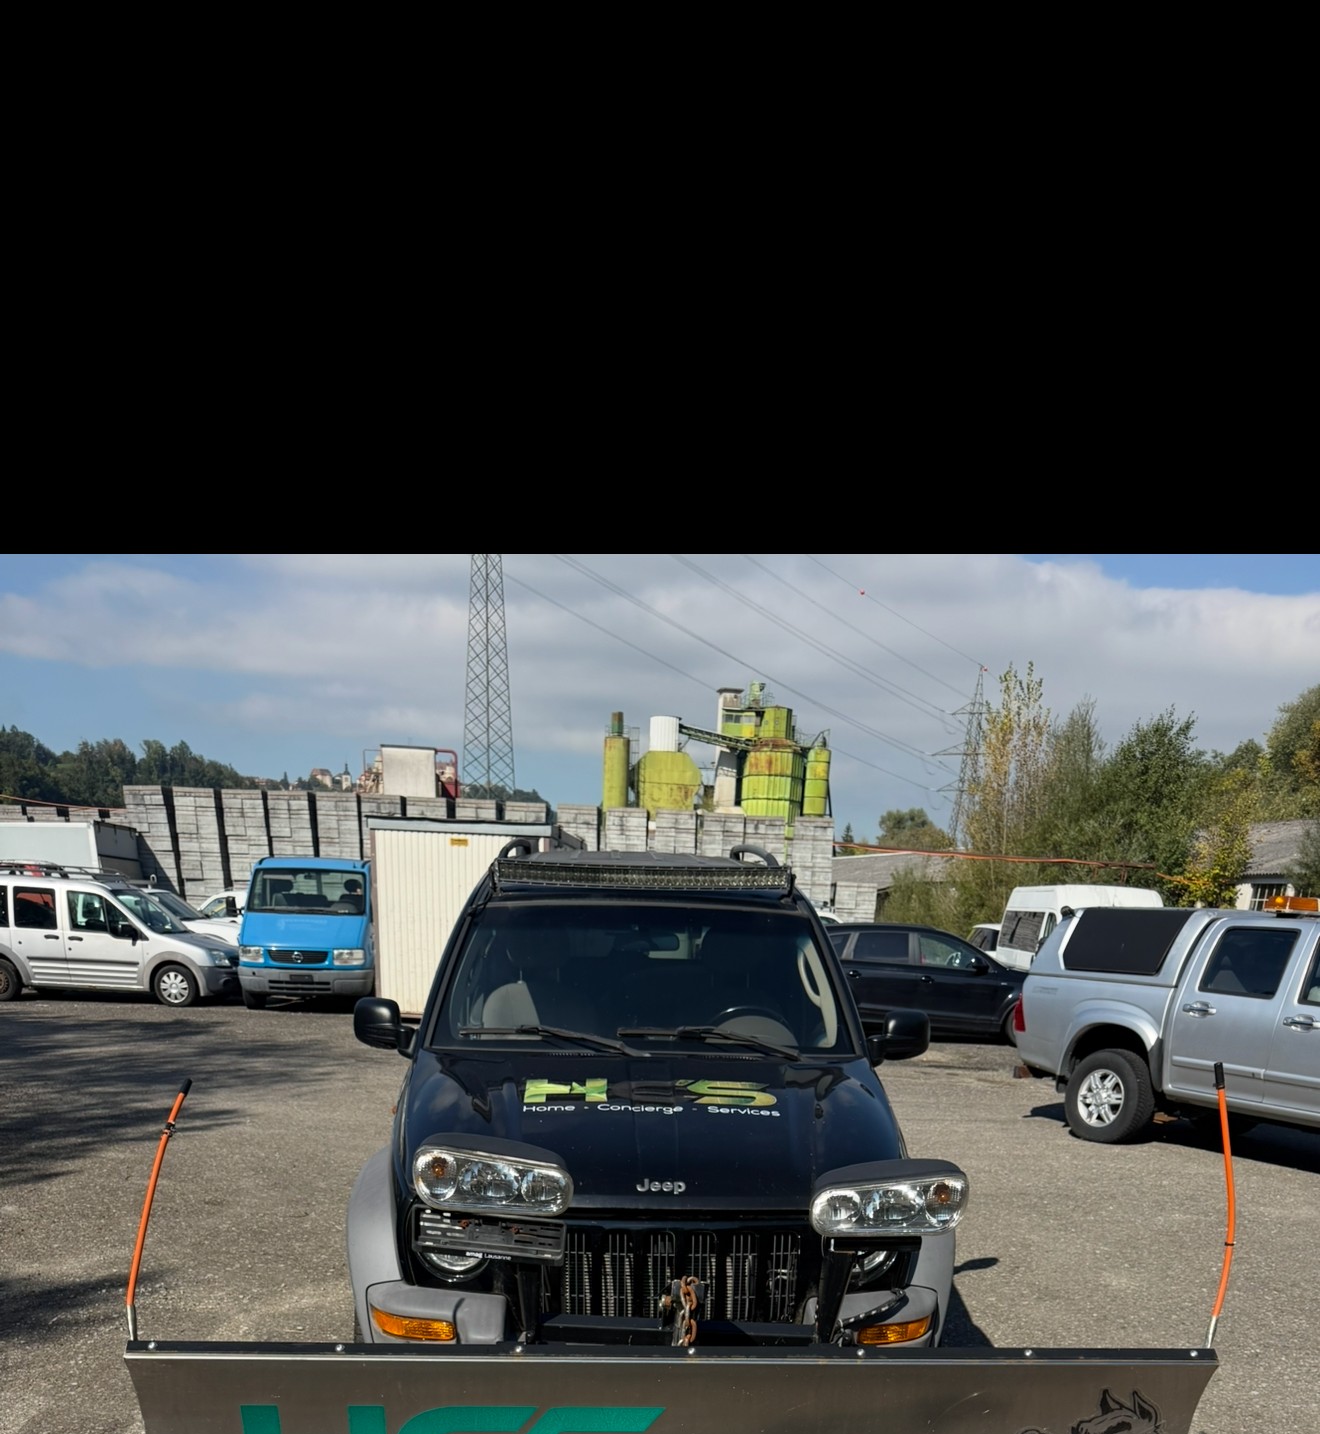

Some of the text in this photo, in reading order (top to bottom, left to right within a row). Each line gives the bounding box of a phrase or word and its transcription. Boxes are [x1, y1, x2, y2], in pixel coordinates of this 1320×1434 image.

[522, 1103, 781, 1117] Home Concierge Services
[636, 1178, 686, 1195] Jeep
[465, 1251, 512, 1261] amag Lausanne
